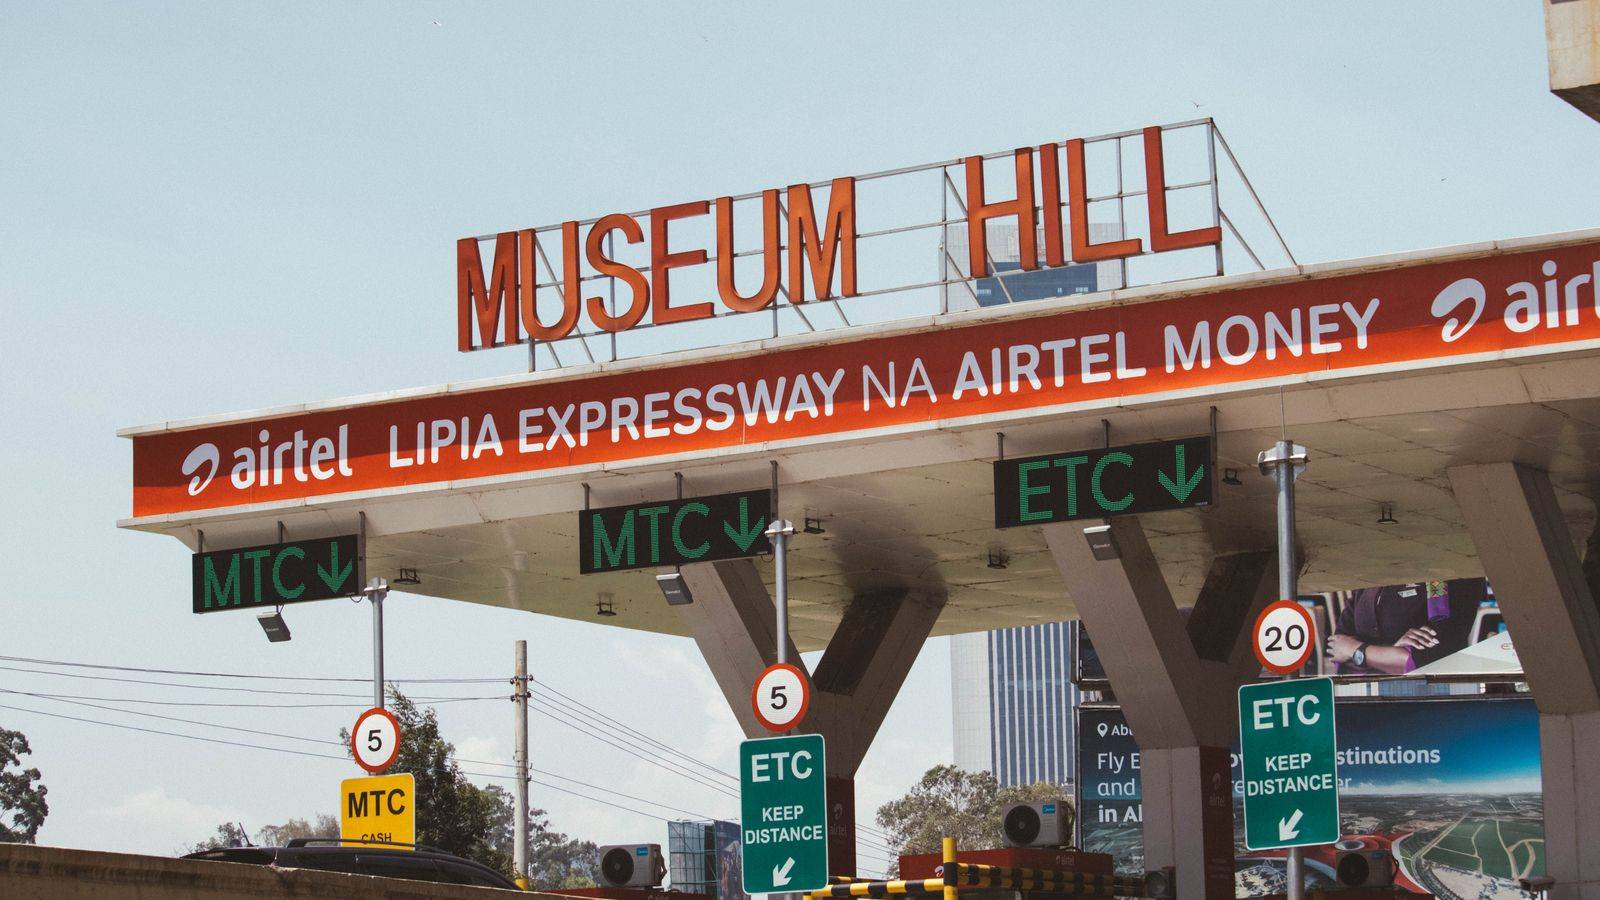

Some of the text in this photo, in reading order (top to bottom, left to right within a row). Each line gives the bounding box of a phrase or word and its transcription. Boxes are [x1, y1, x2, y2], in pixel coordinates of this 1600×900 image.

[457, 126, 1221, 352] MUSEUM HILL
[388, 298, 1380, 469] LIPIA EXPRESSWAY NA AIRTEL MONEY
[230, 424, 353, 490] airtel
[1018, 451, 1135, 522] ETC
[592, 502, 711, 569] MTC
[203, 546, 306, 609] MTC
[1265, 624, 1305, 653] 20
[770, 685, 788, 710] 5
[1252, 694, 1321, 731] ETC
[367, 729, 383, 752] 5
[751, 750, 813, 783] ETC
[1097, 751, 1125, 774] Fly
[1265, 752, 1312, 773] KEEP
[1097, 777, 1136, 797] and
[1247, 773, 1334, 797] DISTANCE
[348, 788, 406, 819] MTC
[762, 805, 804, 823] KEEP
[1098, 804, 1117, 823] in
[361, 832, 392, 846] CASH
[745, 825, 823, 845] DISTANCE
